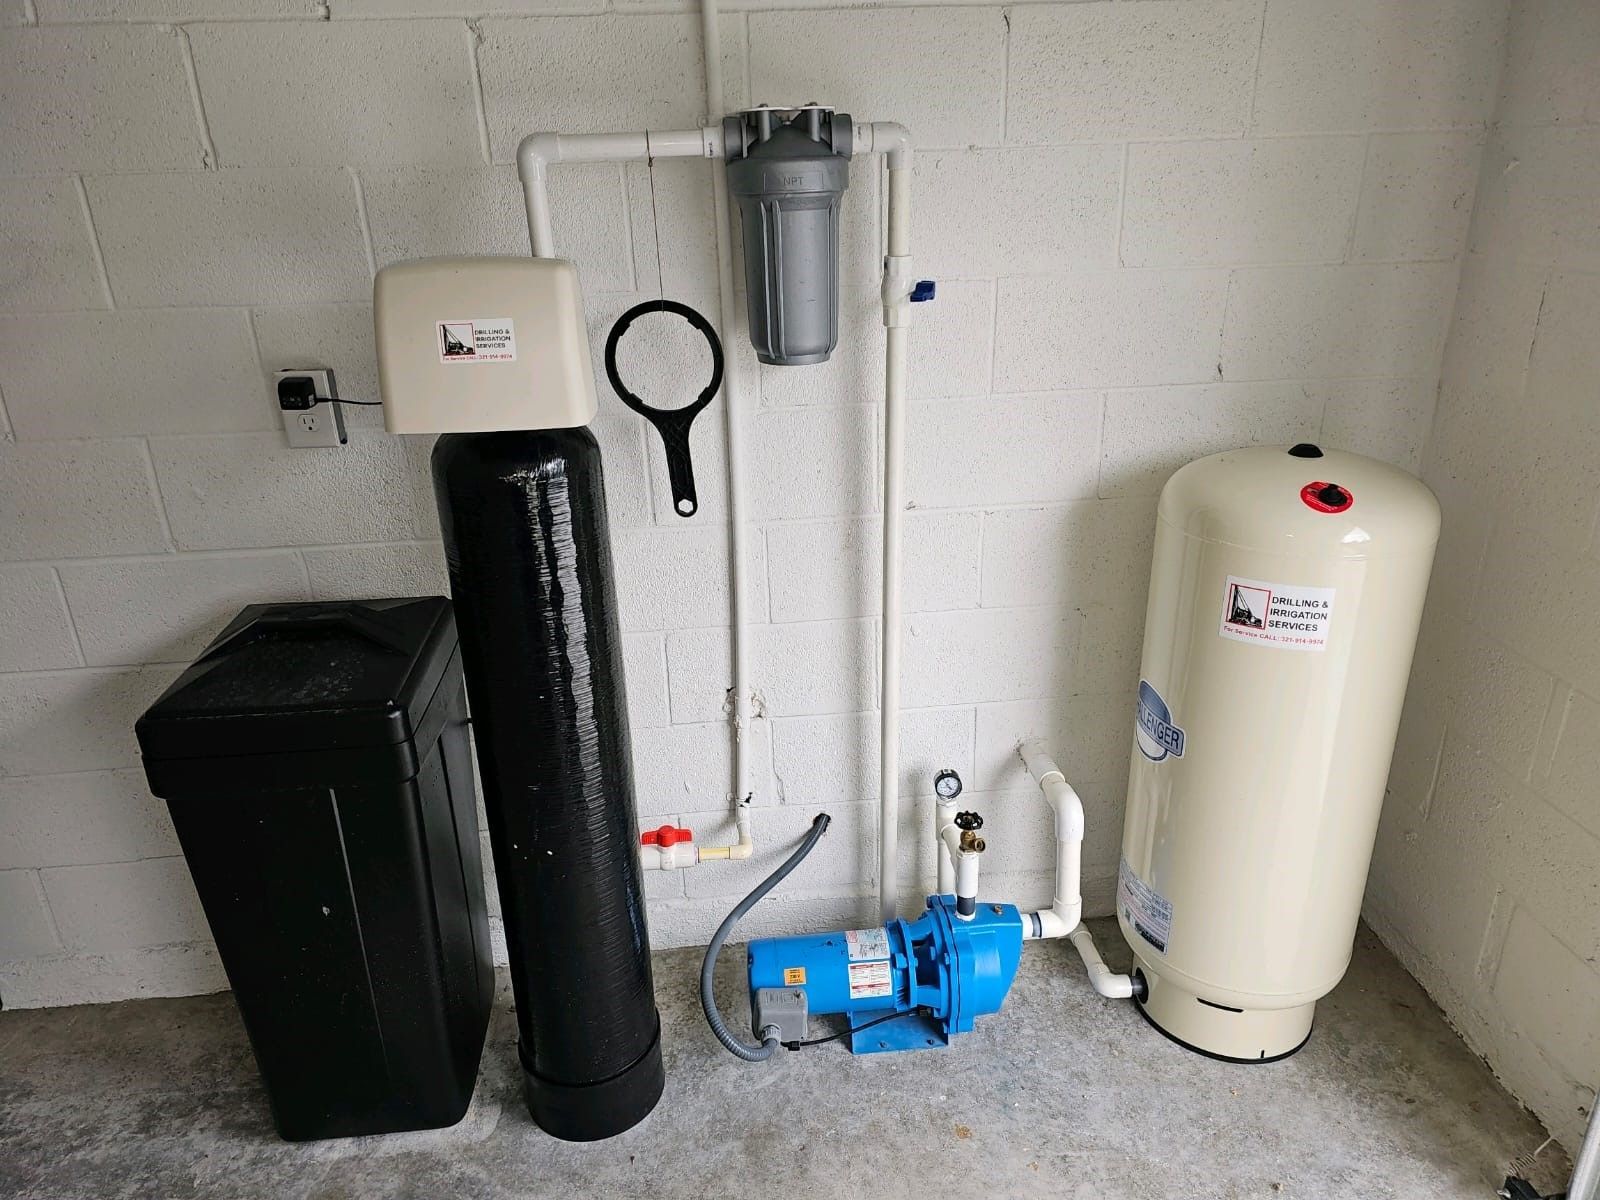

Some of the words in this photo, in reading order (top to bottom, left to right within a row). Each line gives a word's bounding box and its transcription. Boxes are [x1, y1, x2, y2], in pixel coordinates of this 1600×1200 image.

[783, 177, 804, 186] NPT
[1271, 596, 1320, 609] DRILLING
[1321, 600, 1329, 609] &
[1269, 608, 1328, 620] IRRIGATION
[1223, 625, 1234, 633] For
[1235, 629, 1258, 638] Service
[1268, 620, 1319, 632] SERVICES
